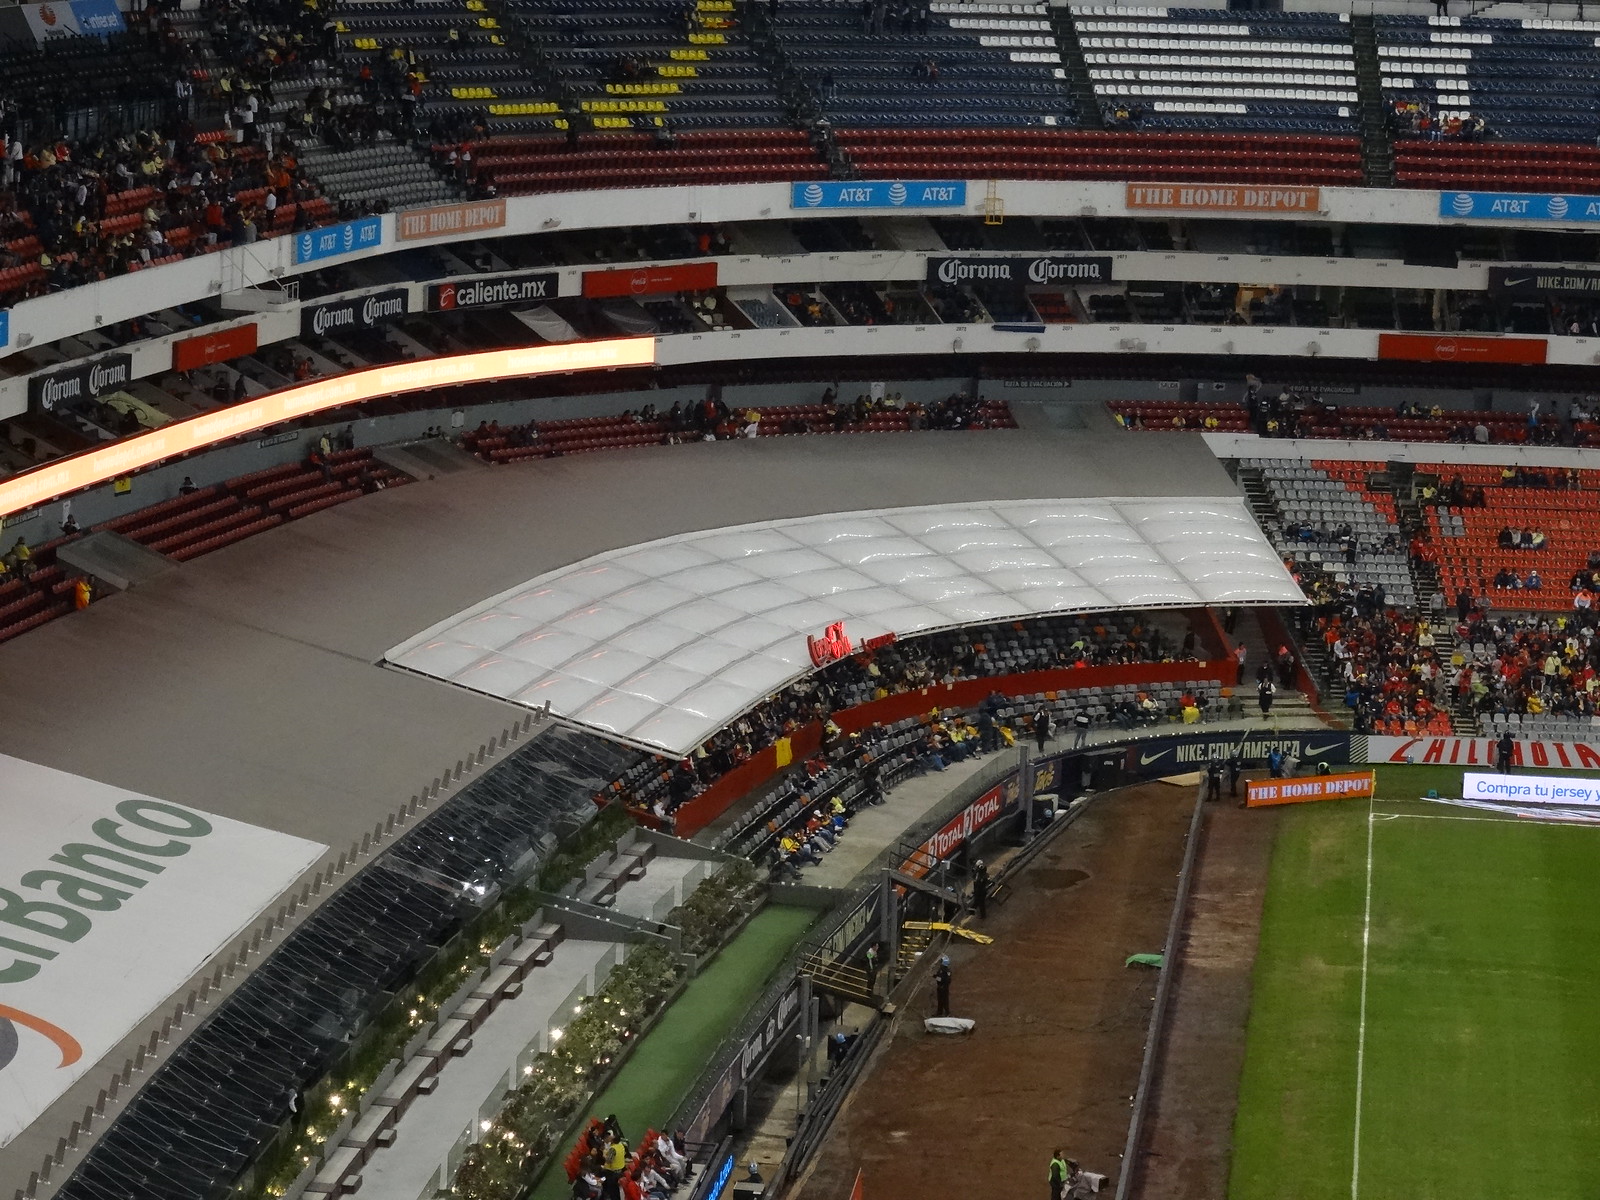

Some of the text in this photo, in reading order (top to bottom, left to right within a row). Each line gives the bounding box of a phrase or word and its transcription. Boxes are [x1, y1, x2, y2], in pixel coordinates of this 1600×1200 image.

[838, 186, 956, 202] AT&T AT&T
[1133, 187, 1309, 208] THE HOME DEPOT
[1490, 199, 1530, 214] AT&T
[404, 205, 501, 235] THE HOME DEPOT
[319, 224, 377, 251] AT&T AT&T
[937, 257, 1100, 285] Corona Corona
[456, 278, 547, 306] caliente.mx
[313, 296, 402, 336] Corona Corona
[507, 346, 618, 370] homedepot.com.mx
[88, 363, 126, 396] Corona
[381, 361, 476, 387] homedepot.com.mx
[42, 376, 81, 411] Corona
[1249, 778, 1371, 801] THE HOME DEPOT
[1477, 781, 1531, 797] Compra
[1535, 784, 1548, 796] tu
[1551, 785, 1592, 801] jersey
[973, 796, 1000, 825] TOTAL
[938, 823, 963, 855] TOTAL
